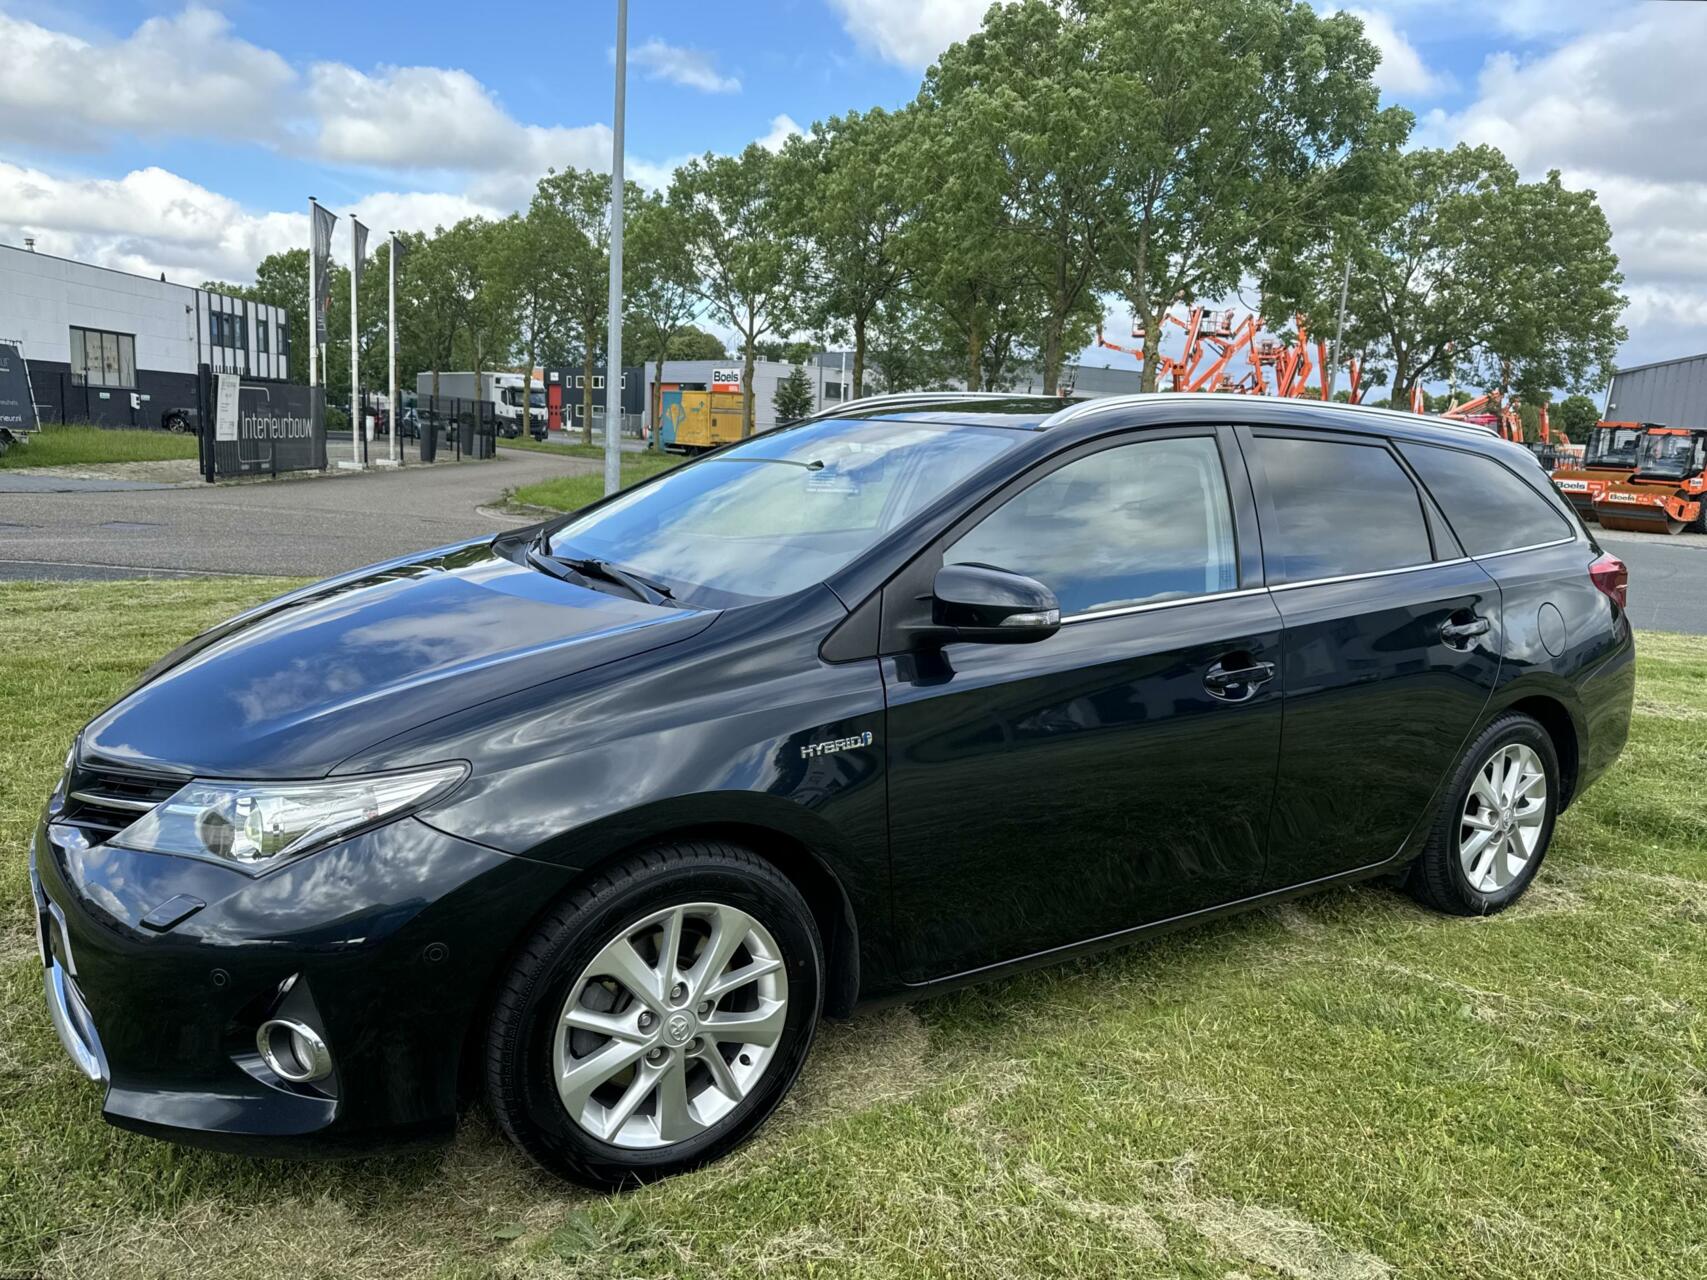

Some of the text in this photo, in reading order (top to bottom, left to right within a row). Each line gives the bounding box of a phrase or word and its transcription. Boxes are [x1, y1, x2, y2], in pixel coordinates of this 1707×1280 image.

[713, 371, 739, 382] Boels
[241, 410, 313, 439] Interieurbouw
[800, 735, 863, 759] HYBRID
